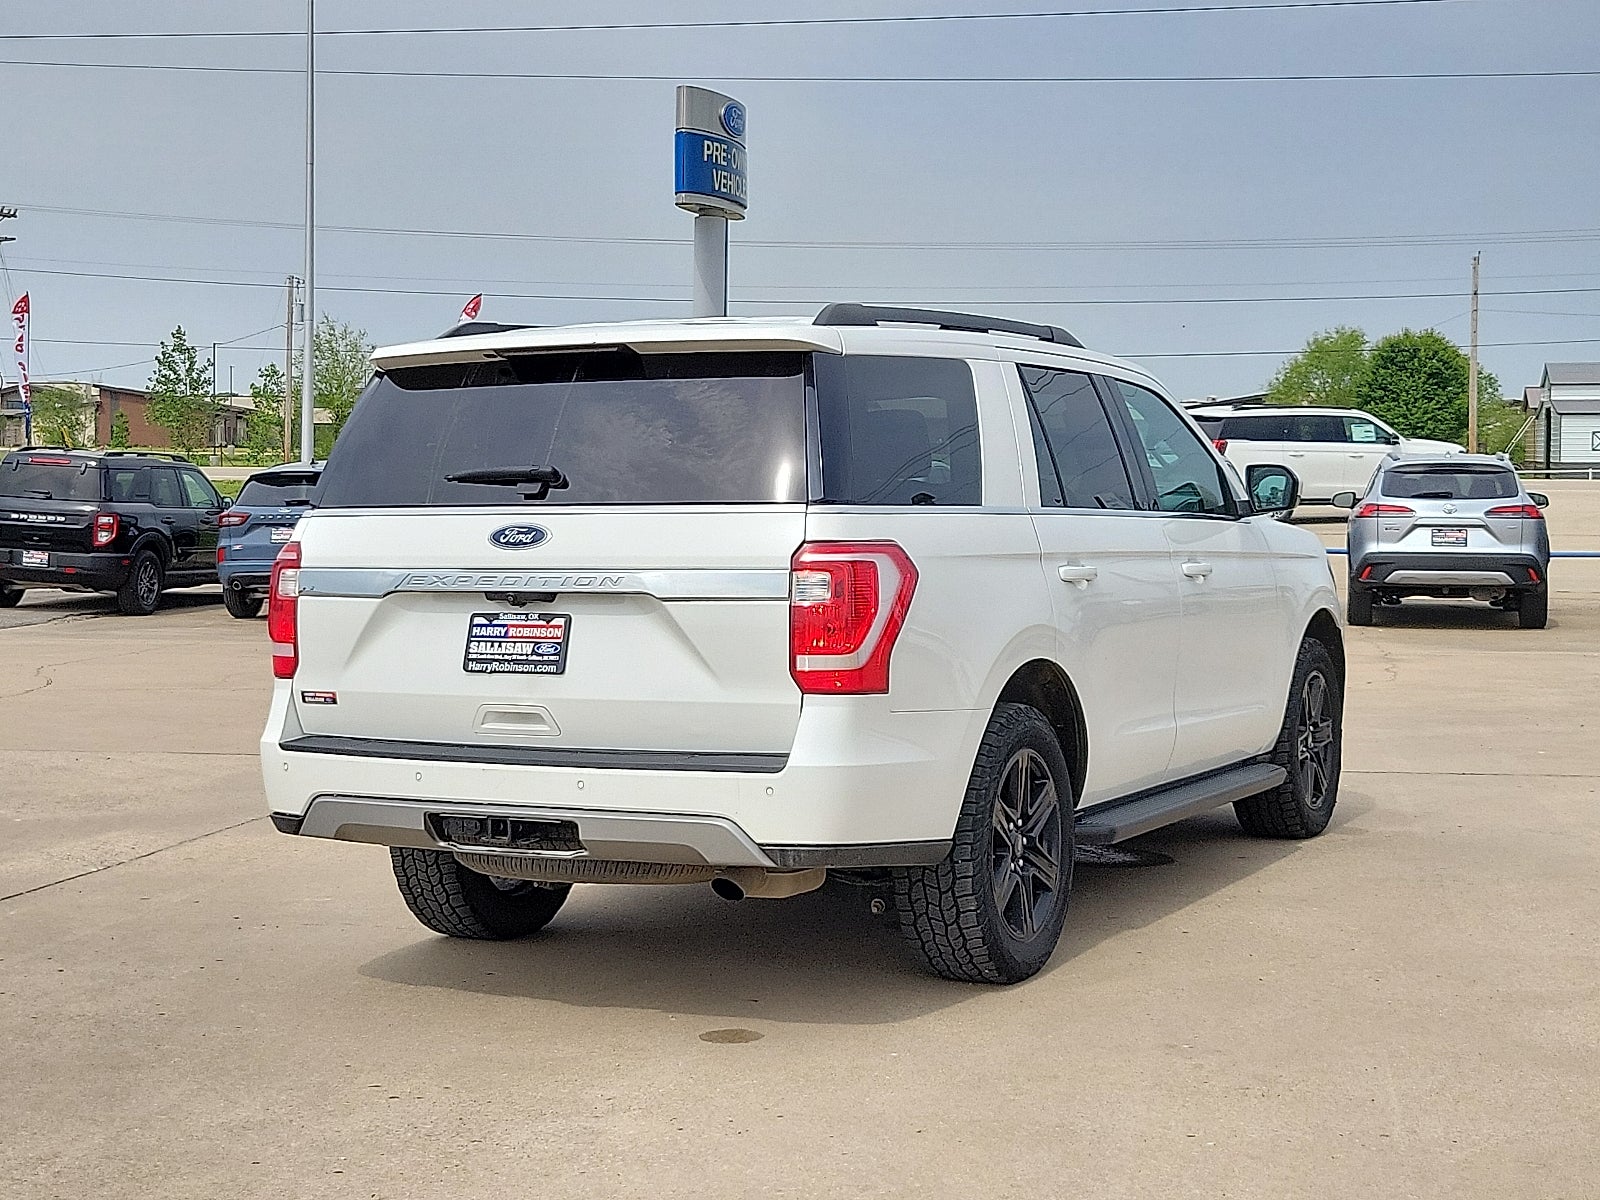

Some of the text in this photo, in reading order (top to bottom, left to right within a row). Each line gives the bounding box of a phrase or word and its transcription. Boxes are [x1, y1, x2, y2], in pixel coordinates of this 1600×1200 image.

[499, 527, 536, 543] Ford
[406, 575, 625, 588] EXPEDITION
[471, 626, 562, 638] HARRY ROBINSON
[468, 641, 534, 654] SALLISAW
[468, 661, 557, 673] HarryRobinson.com
